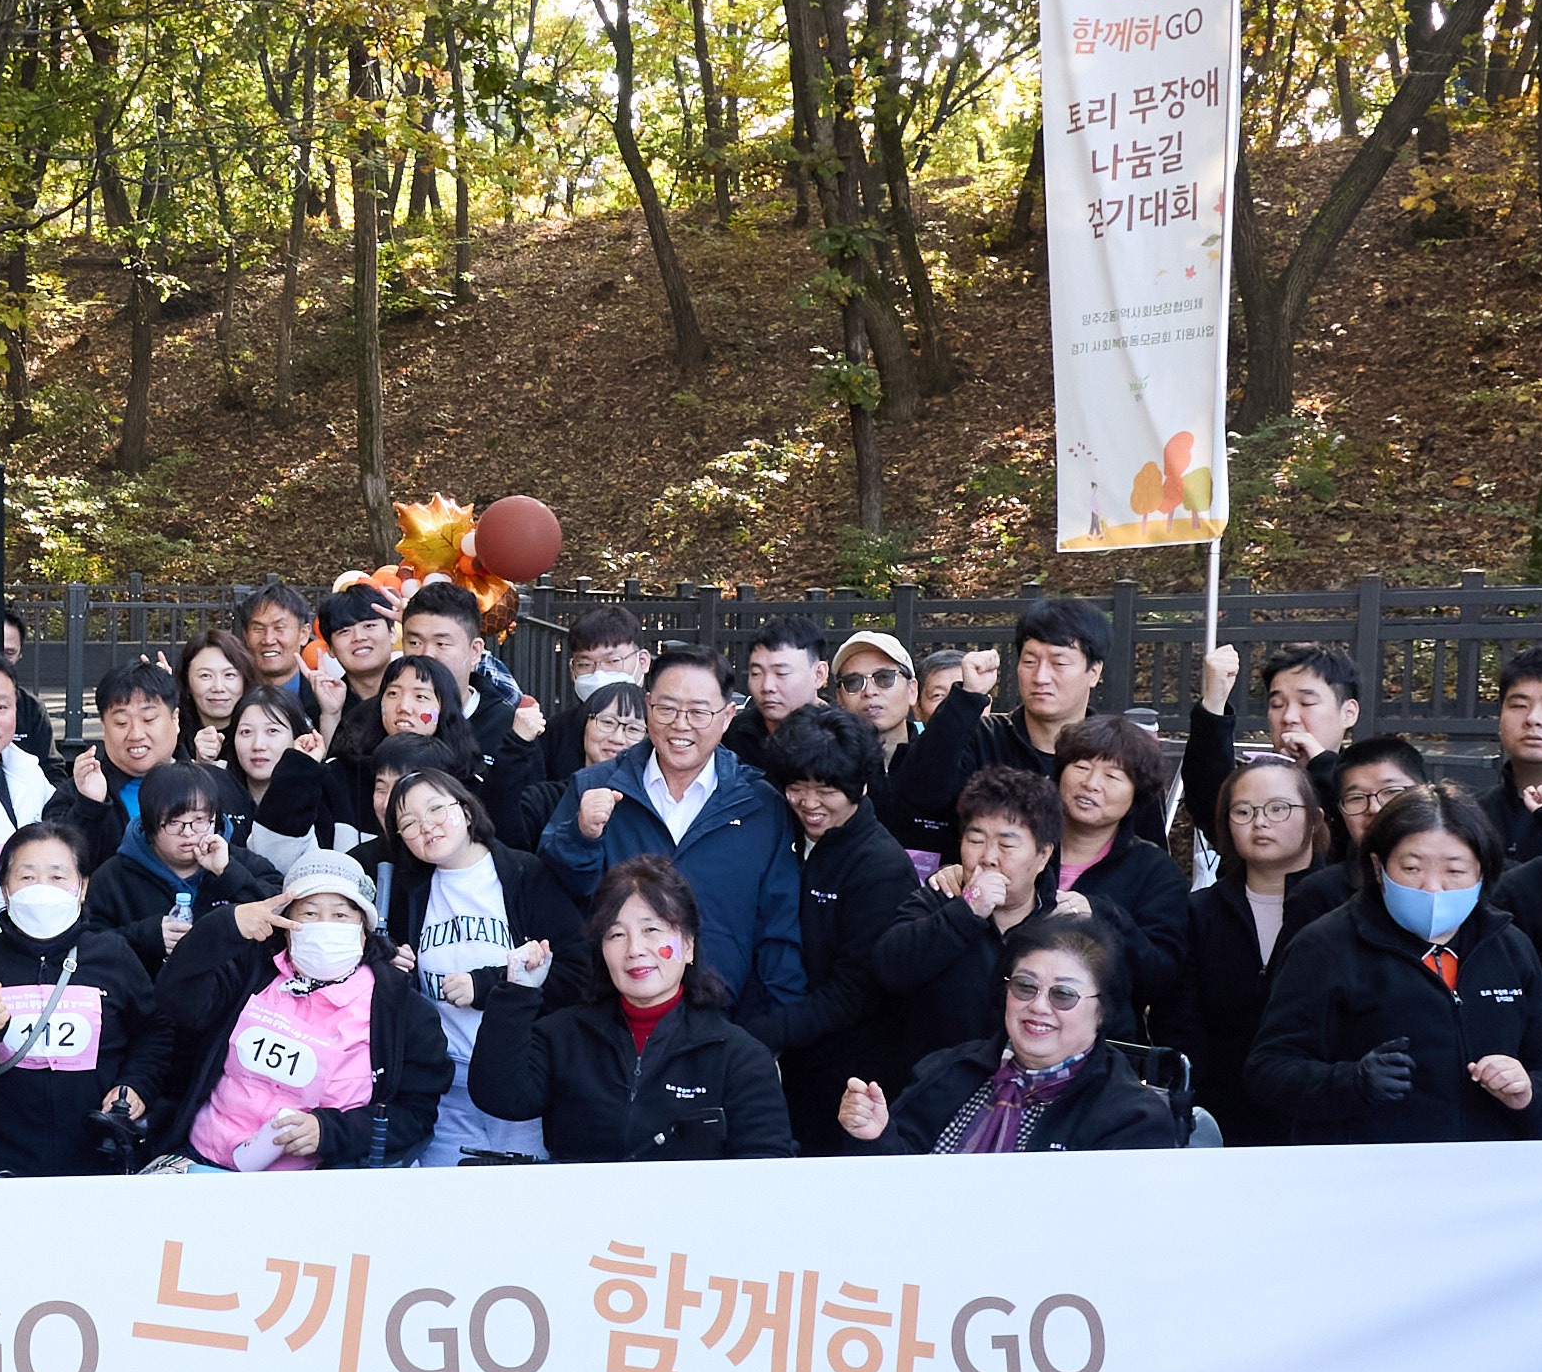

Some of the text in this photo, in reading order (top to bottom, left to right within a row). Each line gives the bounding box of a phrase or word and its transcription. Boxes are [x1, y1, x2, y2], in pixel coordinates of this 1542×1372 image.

[1073, 8, 1203, 54] 함께하GO
[1066, 66, 1219, 135] 토리 무장애
[1091, 130, 1184, 181] 나눔길
[1087, 181, 1198, 239] 걷기대회
[1070, 340, 1089, 356] 경기
[1174, 324, 1215, 342] 지원사업
[252, 1037, 301, 1077] 151
